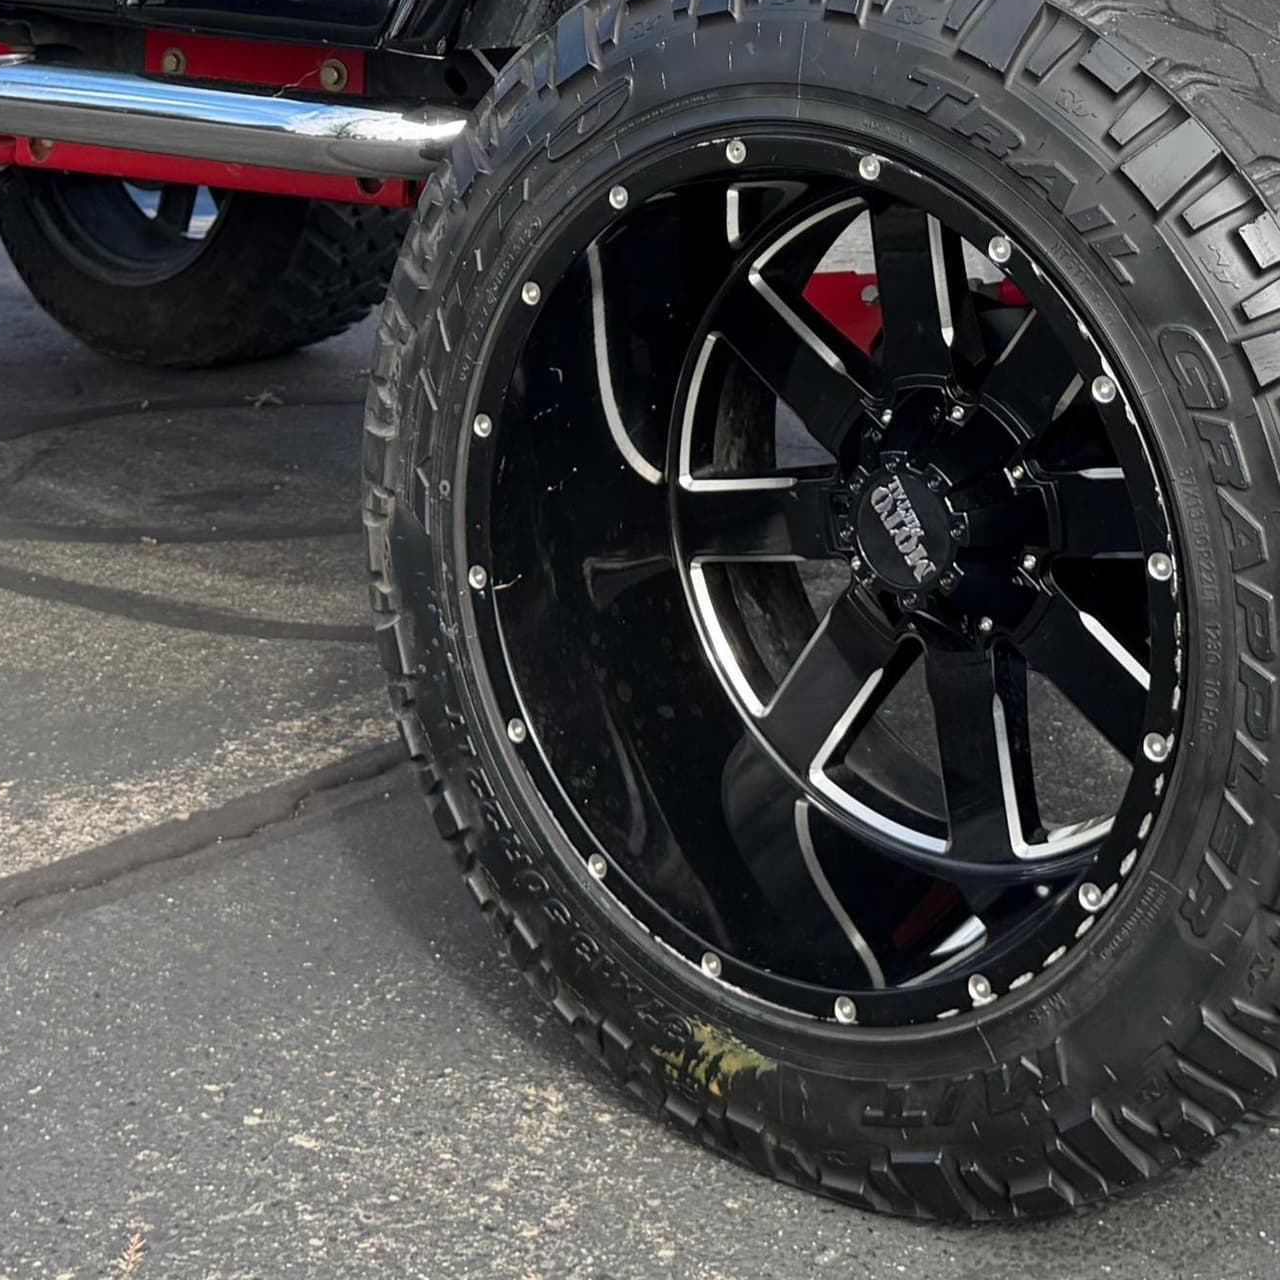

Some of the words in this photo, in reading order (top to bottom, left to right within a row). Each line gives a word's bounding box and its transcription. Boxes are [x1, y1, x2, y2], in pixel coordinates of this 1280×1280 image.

[870, 485, 937, 583] MOTO
[907, 64, 1140, 286] TRAIL
[1158, 324, 1276, 938] GRAPPLER
